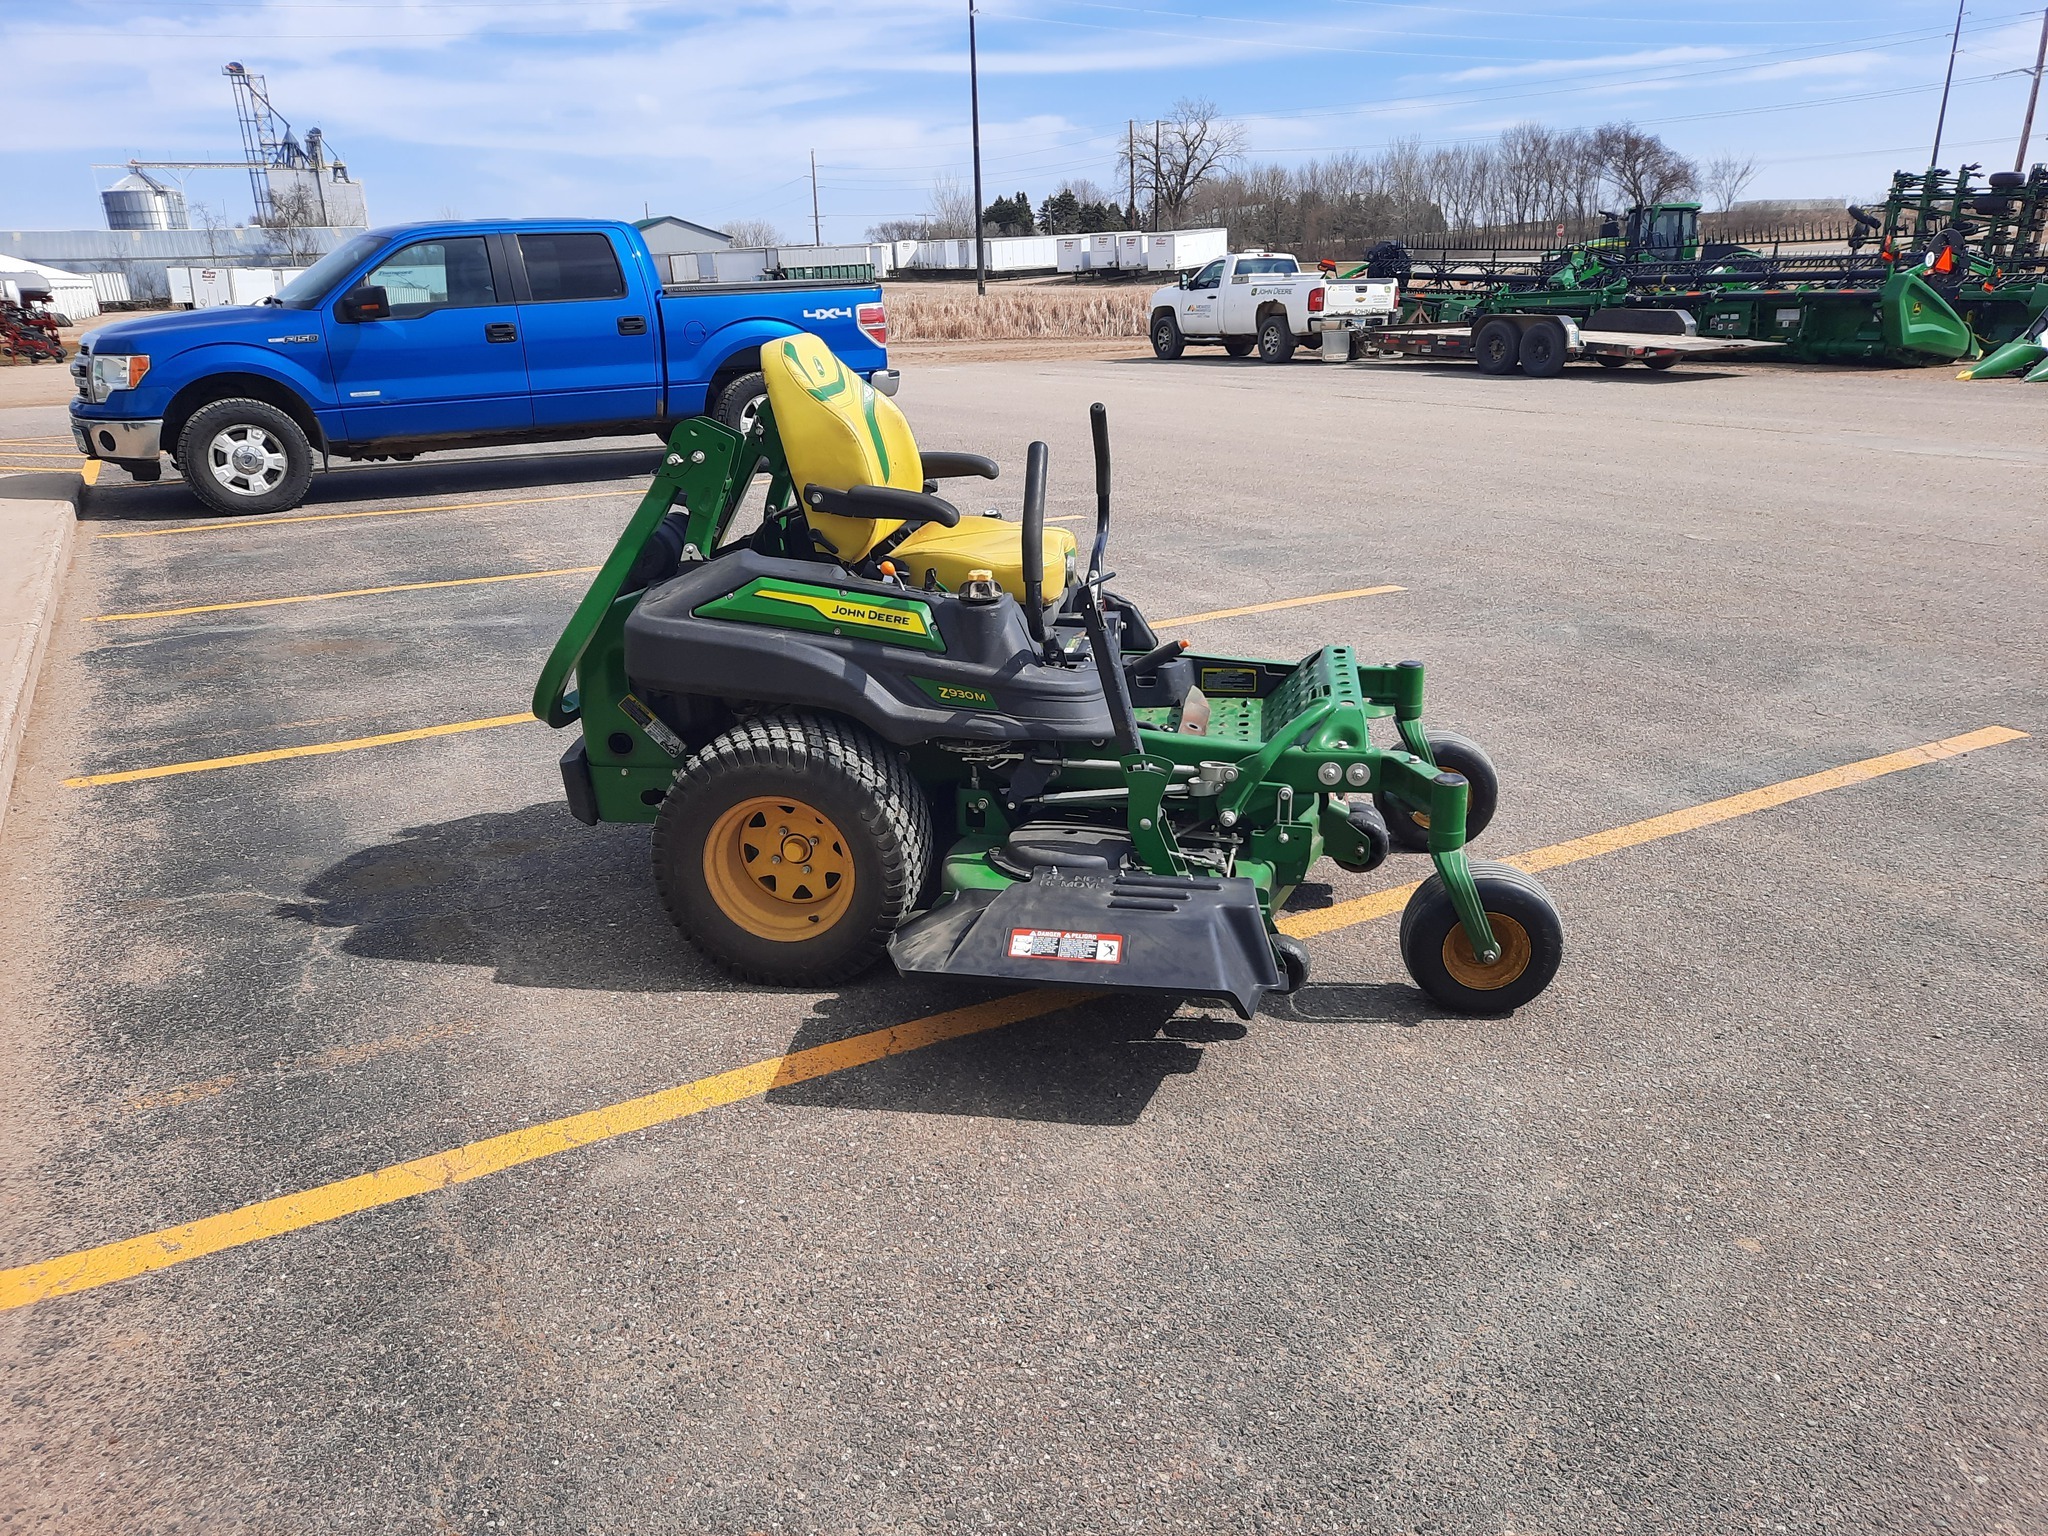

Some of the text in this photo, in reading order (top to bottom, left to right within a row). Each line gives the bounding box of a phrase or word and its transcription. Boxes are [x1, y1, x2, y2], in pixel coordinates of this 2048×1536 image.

[1273, 287, 1293, 295] DEERE
[832, 605, 910, 625] JOHN DEERE
